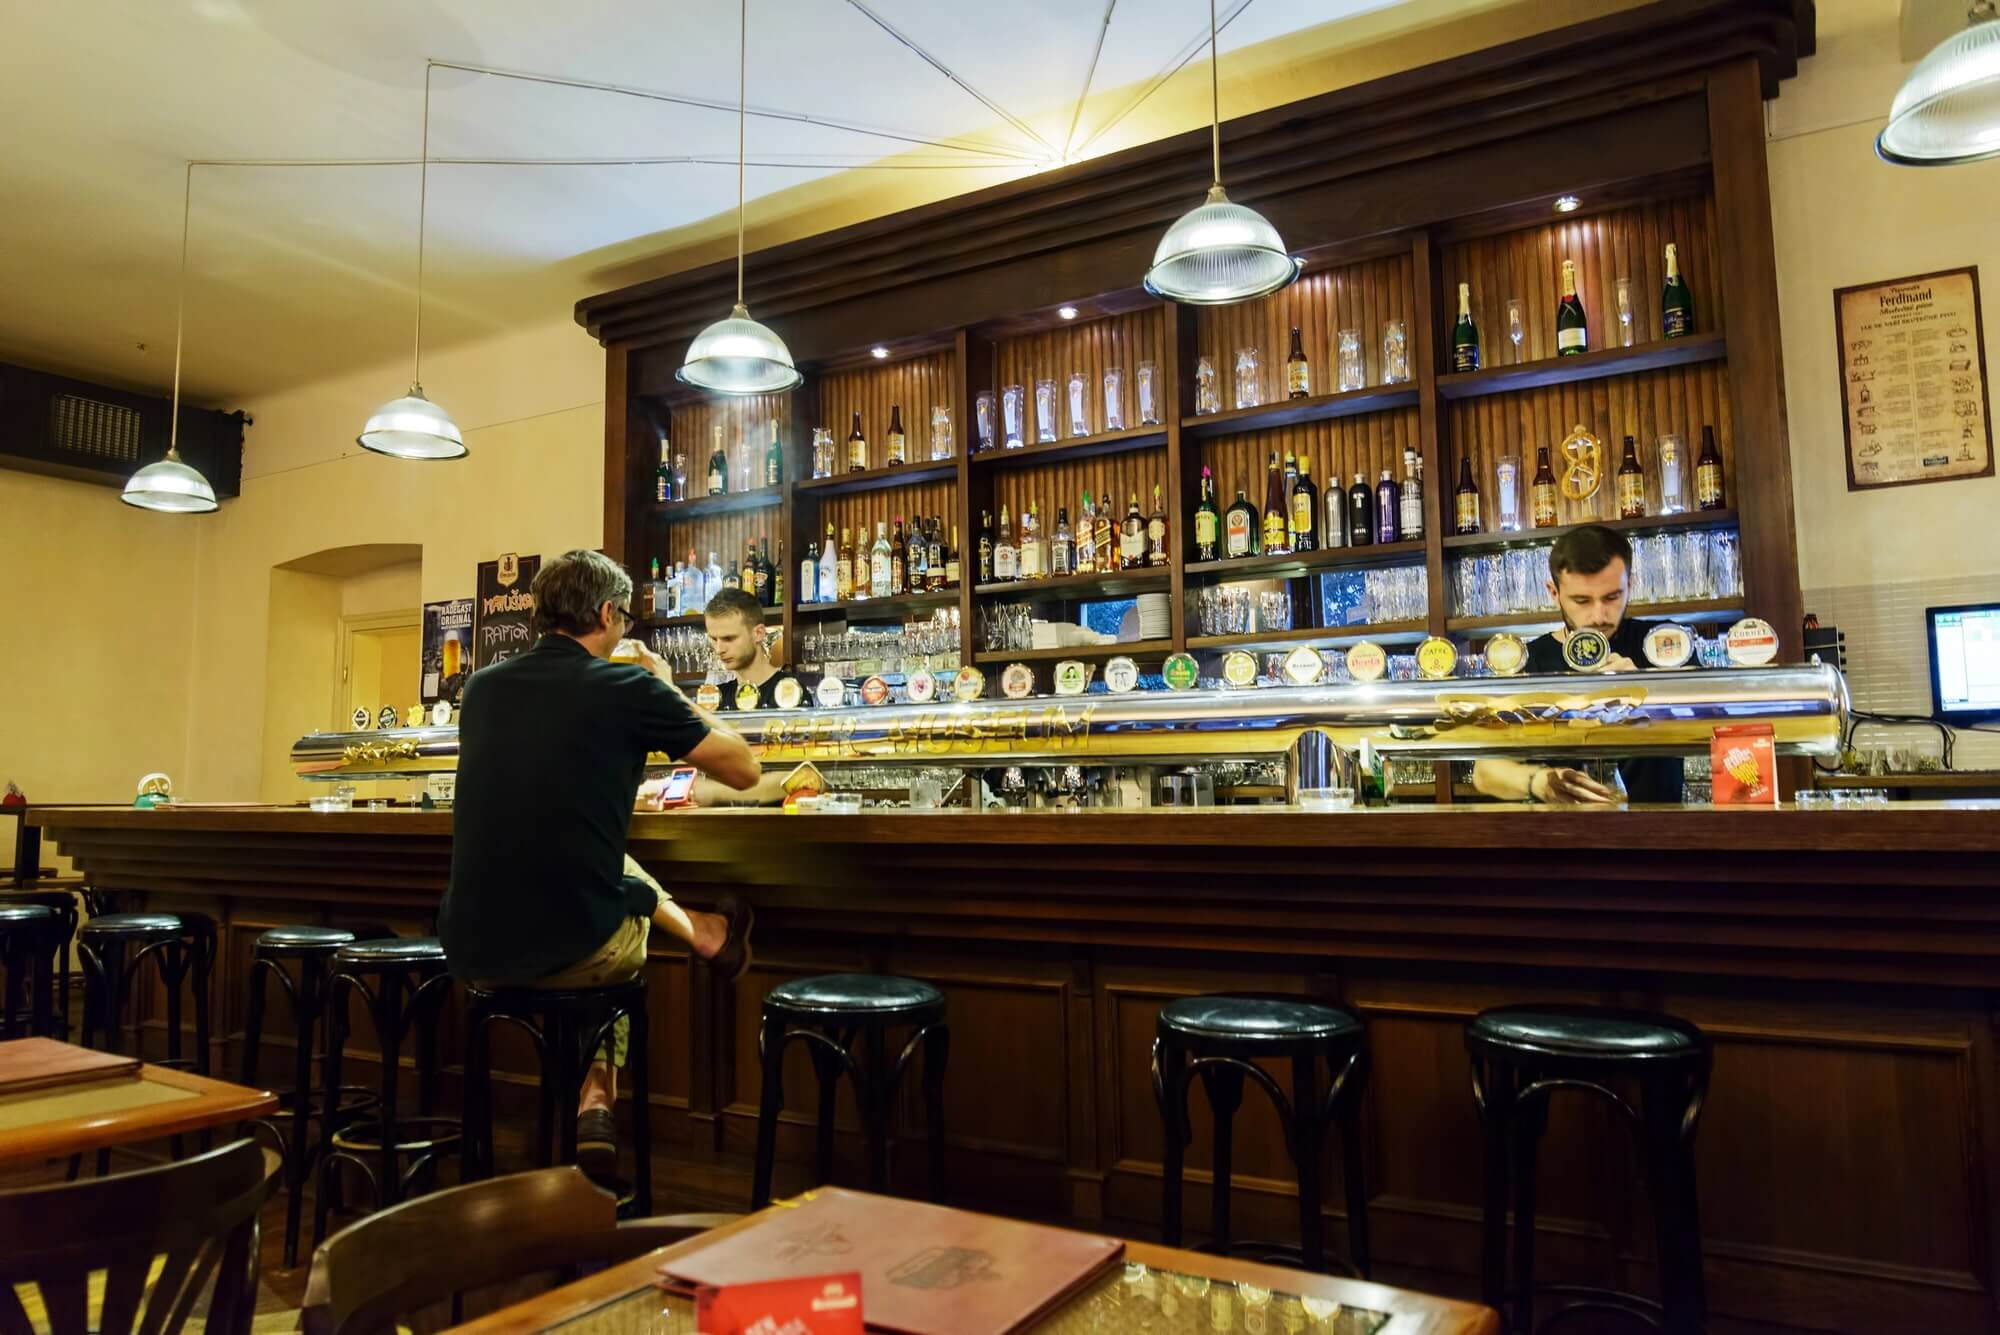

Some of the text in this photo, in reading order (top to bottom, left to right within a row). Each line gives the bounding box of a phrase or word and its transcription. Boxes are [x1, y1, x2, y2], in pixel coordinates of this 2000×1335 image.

[1880, 288, 1933, 307] Ferdinand
[441, 603, 472, 616] RADEGAST
[482, 622, 529, 647] RAPTOR
